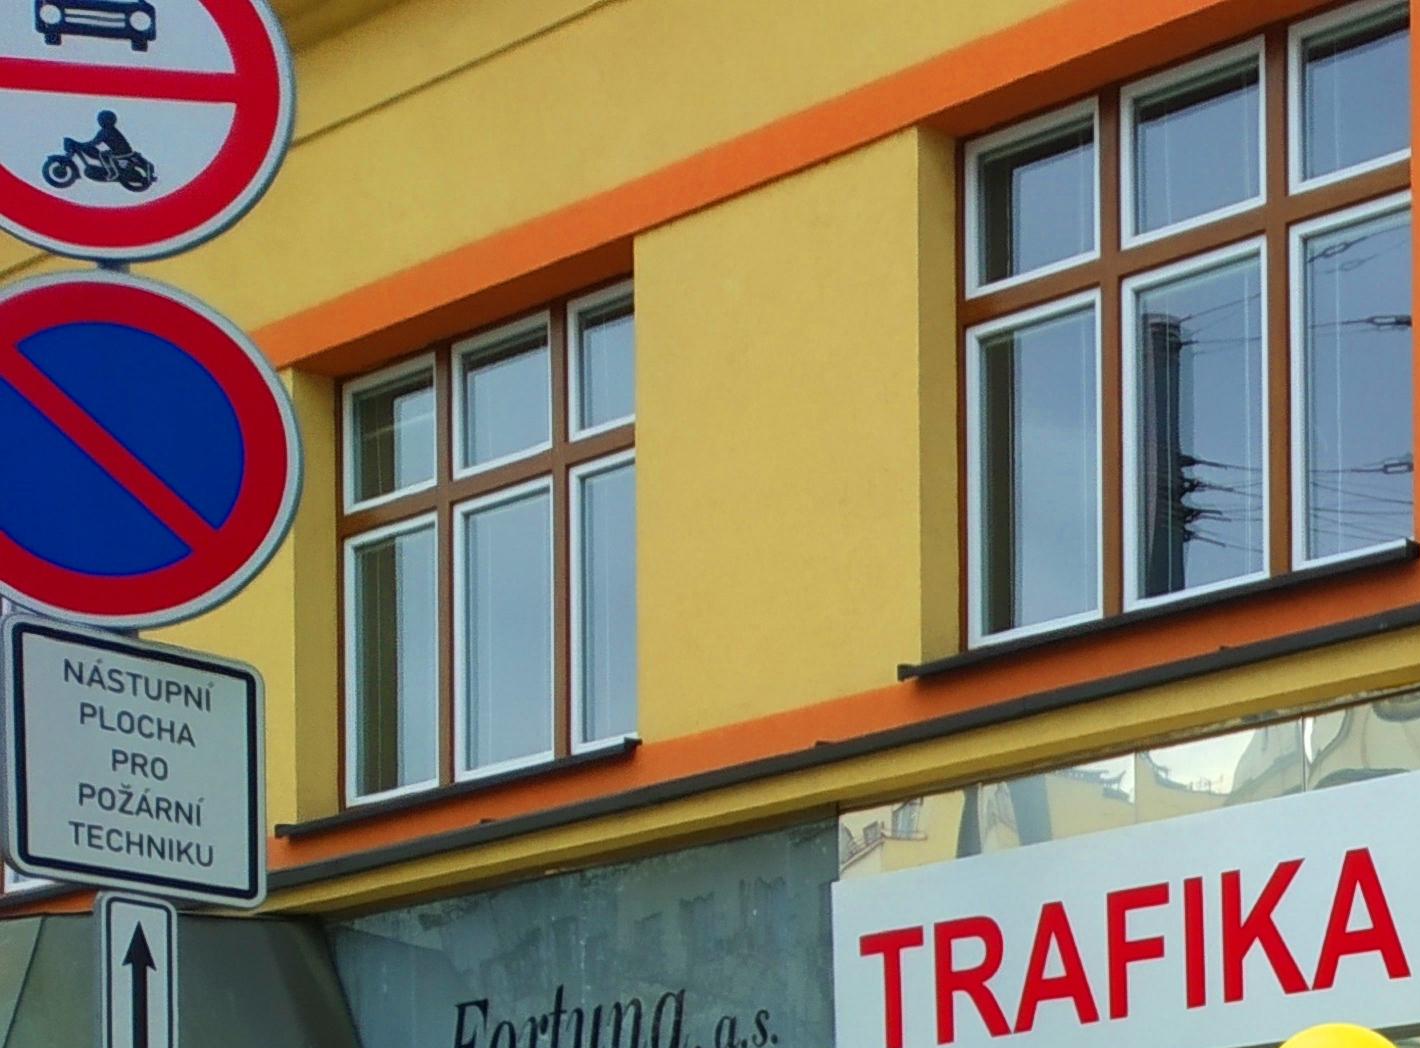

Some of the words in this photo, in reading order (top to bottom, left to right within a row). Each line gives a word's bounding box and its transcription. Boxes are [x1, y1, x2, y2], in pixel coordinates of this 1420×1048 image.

[63, 658, 214, 712] NÁSTUPNÍ
[79, 702, 196, 748] PLOCHA
[111, 749, 169, 781] PRO
[78, 782, 204, 827] POŽÁRNÍ
[68, 821, 214, 867] TECHNIKU
